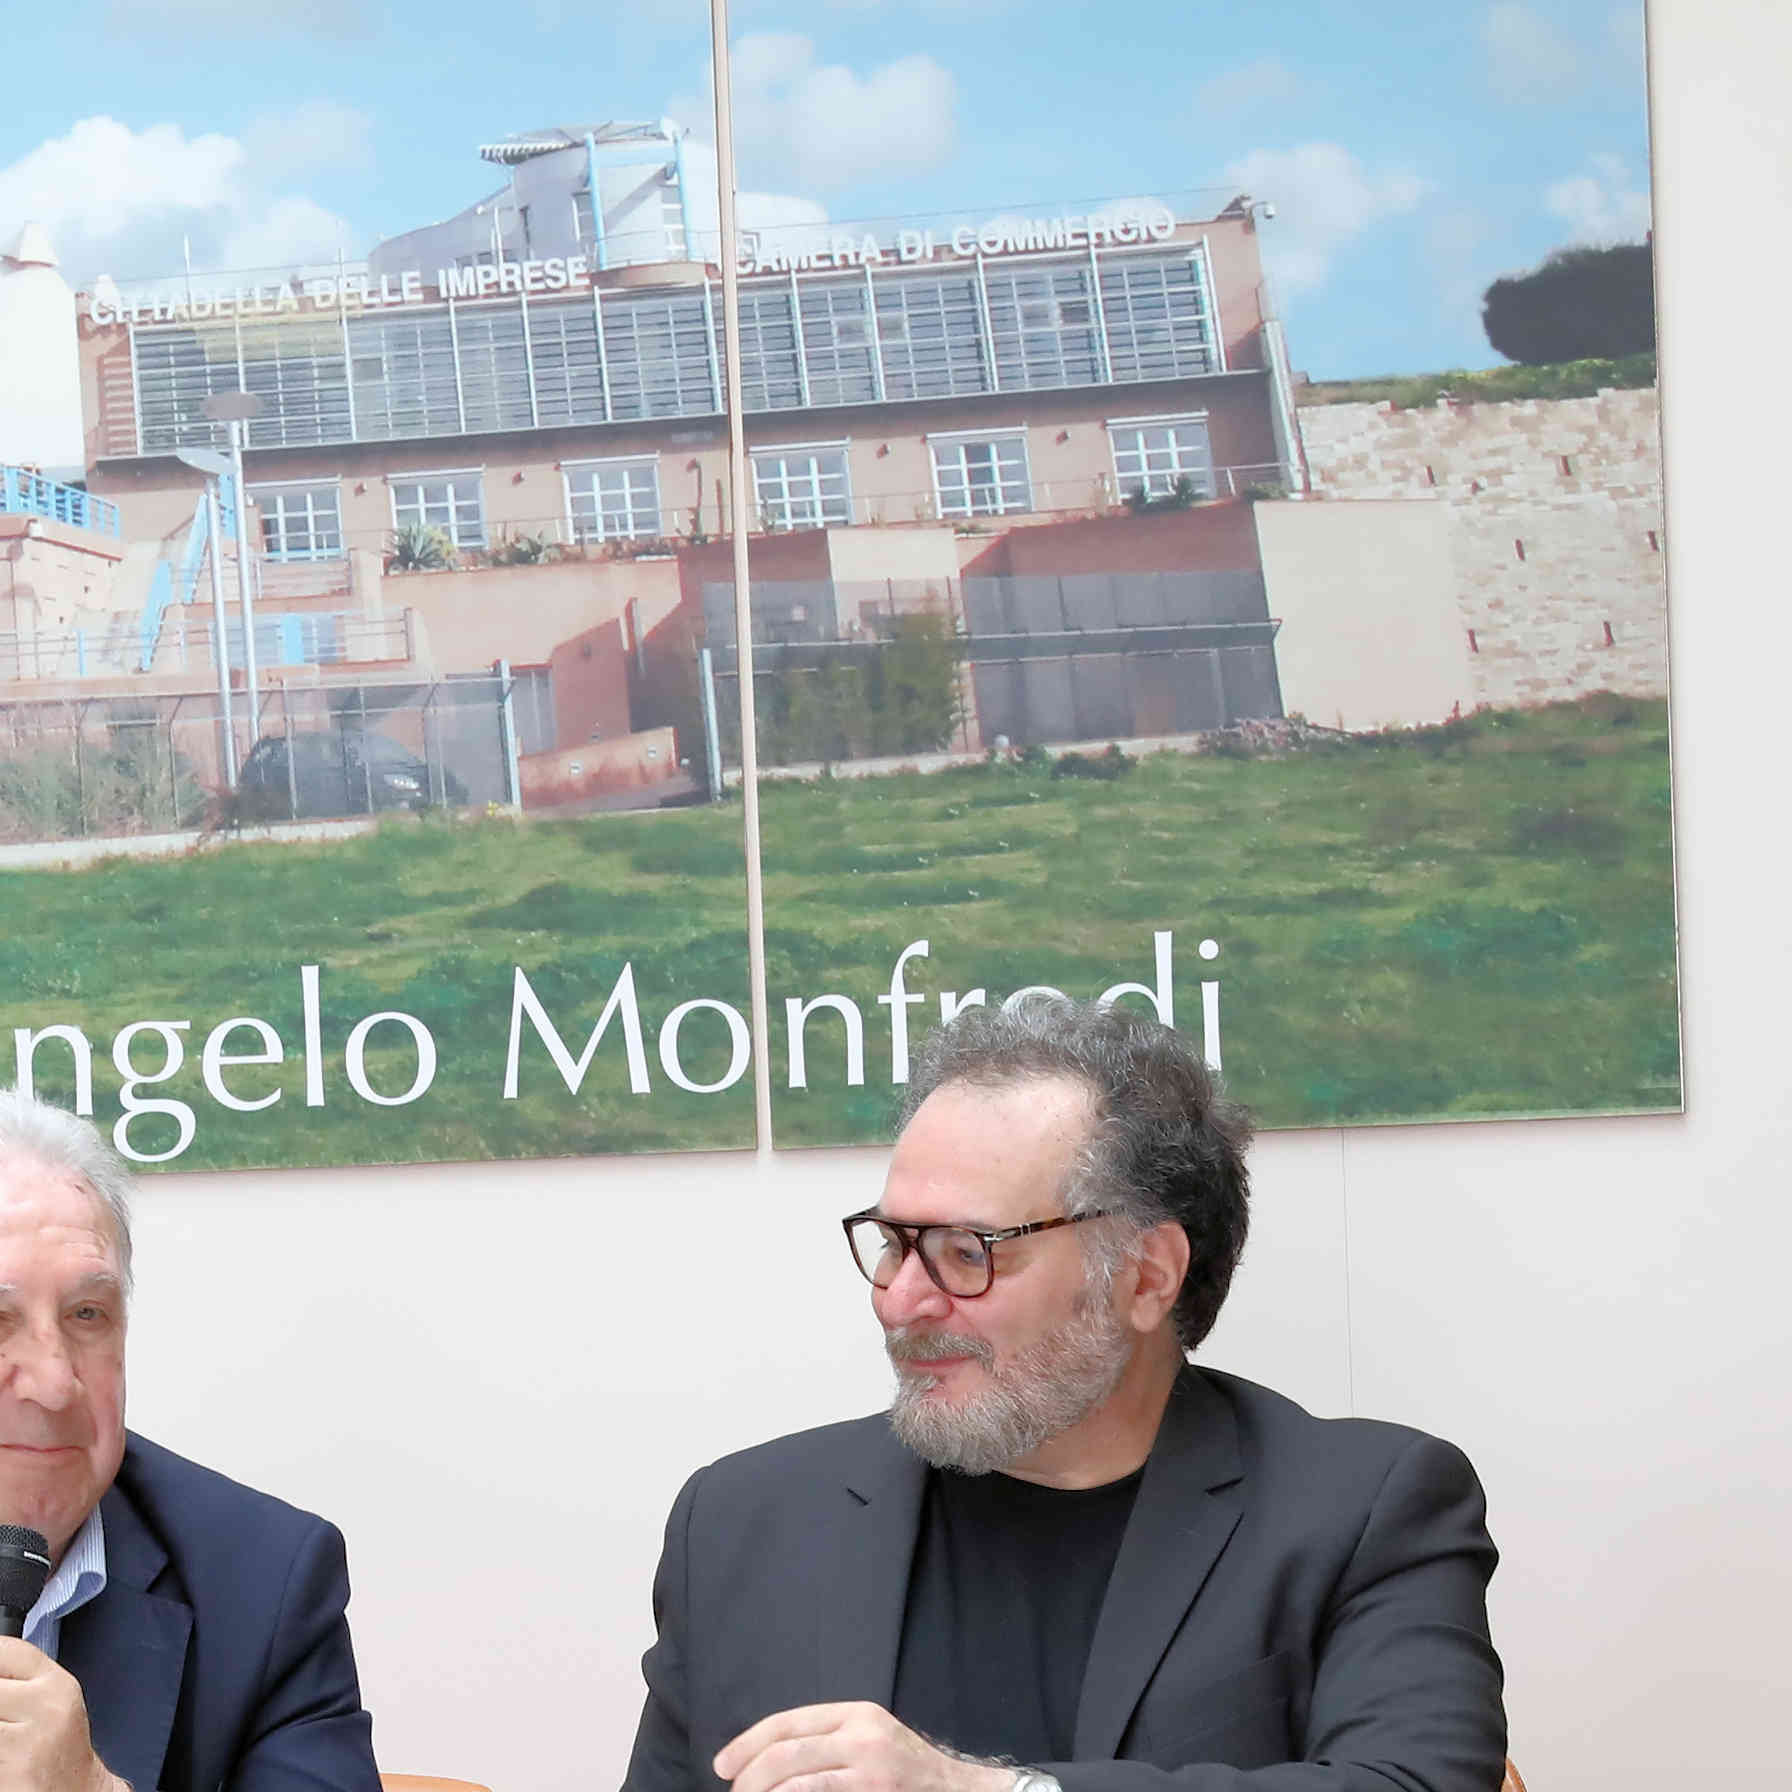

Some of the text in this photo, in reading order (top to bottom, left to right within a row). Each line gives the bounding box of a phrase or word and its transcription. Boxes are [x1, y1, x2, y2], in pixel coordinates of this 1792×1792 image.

[900, 229, 935, 262] DI
[952, 208, 1175, 256] COMMERCIO
[438, 254, 590, 299] IMPRESE
